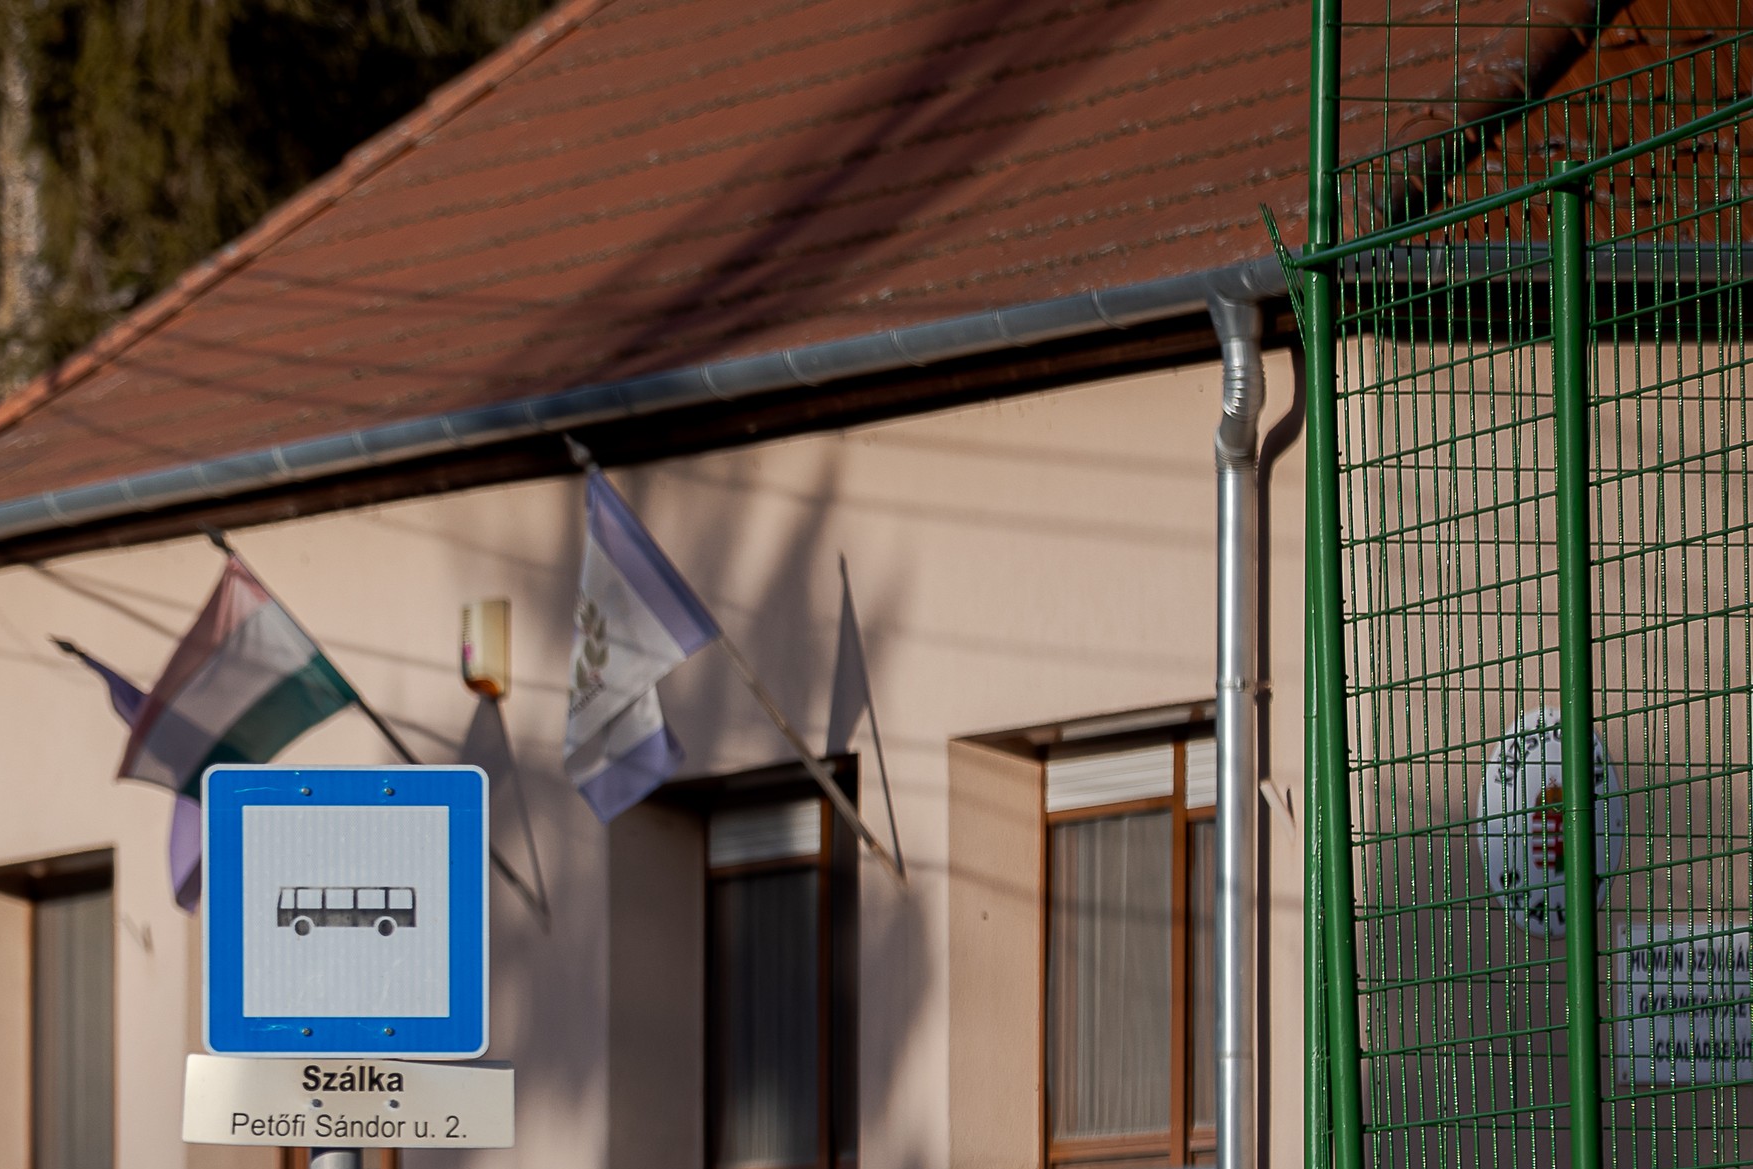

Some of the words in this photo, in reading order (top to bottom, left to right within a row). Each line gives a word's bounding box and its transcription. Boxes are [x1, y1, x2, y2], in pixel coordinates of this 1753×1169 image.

[302, 1064, 404, 1092] Szálka
[231, 1112, 305, 1137] Petőfi
[315, 1113, 405, 1139] Sándor
[414, 1120, 436, 1139] u.
[445, 1115, 467, 1139] 2.
